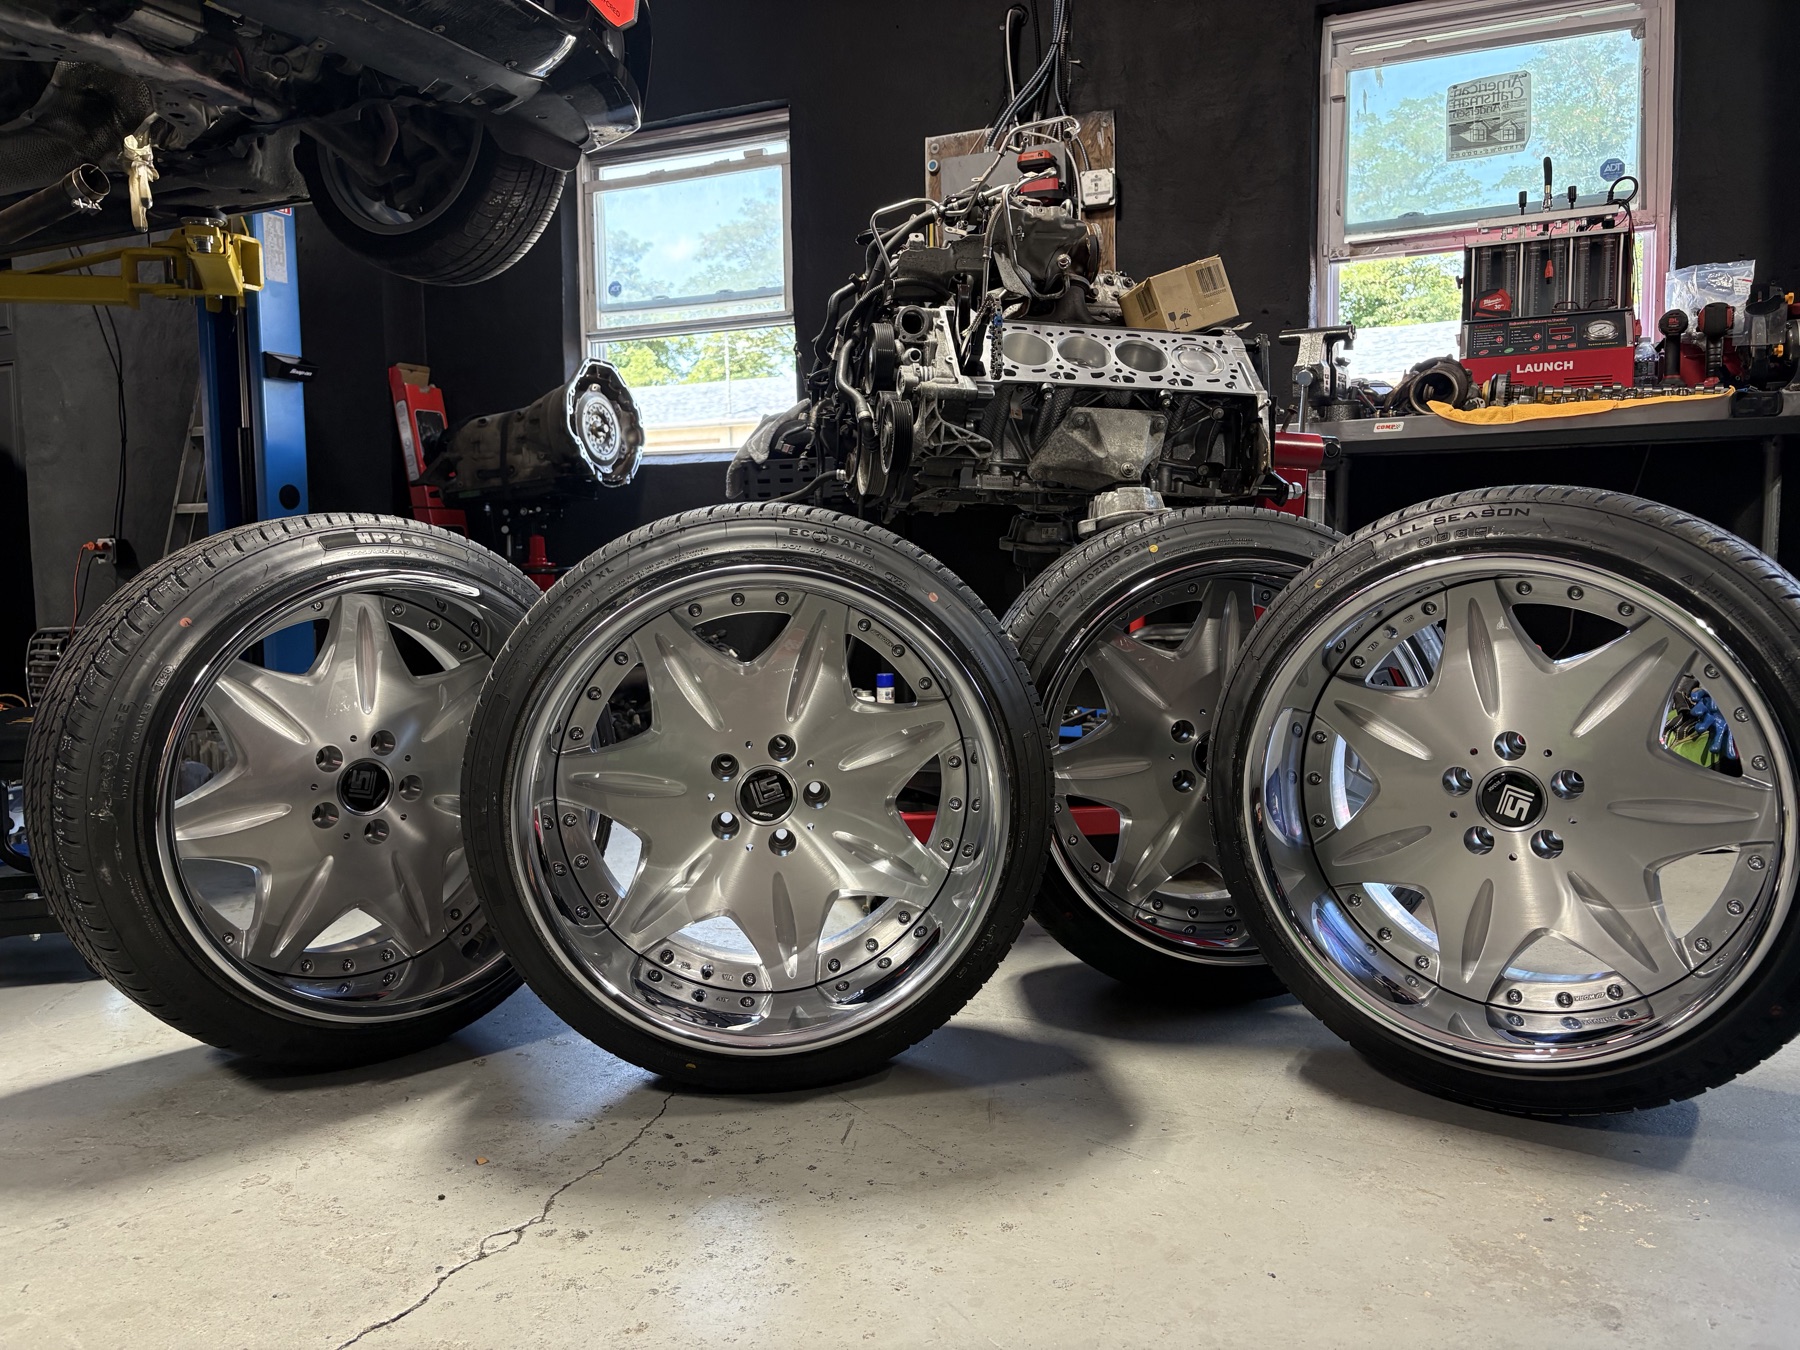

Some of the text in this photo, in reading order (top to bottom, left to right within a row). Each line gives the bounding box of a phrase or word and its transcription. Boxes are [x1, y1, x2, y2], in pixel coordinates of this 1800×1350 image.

[1603, 162, 1622, 172] ADT
[1516, 361, 1574, 374] LAUNCH
[1384, 524, 1423, 542] ALL
[1433, 508, 1530, 526] SEASON
[596, 566, 614, 580] XL
[1056, 555, 1121, 609] 225/40ZR19
[1124, 540, 1150, 557] 93W
[1153, 534, 1170, 544] XL
